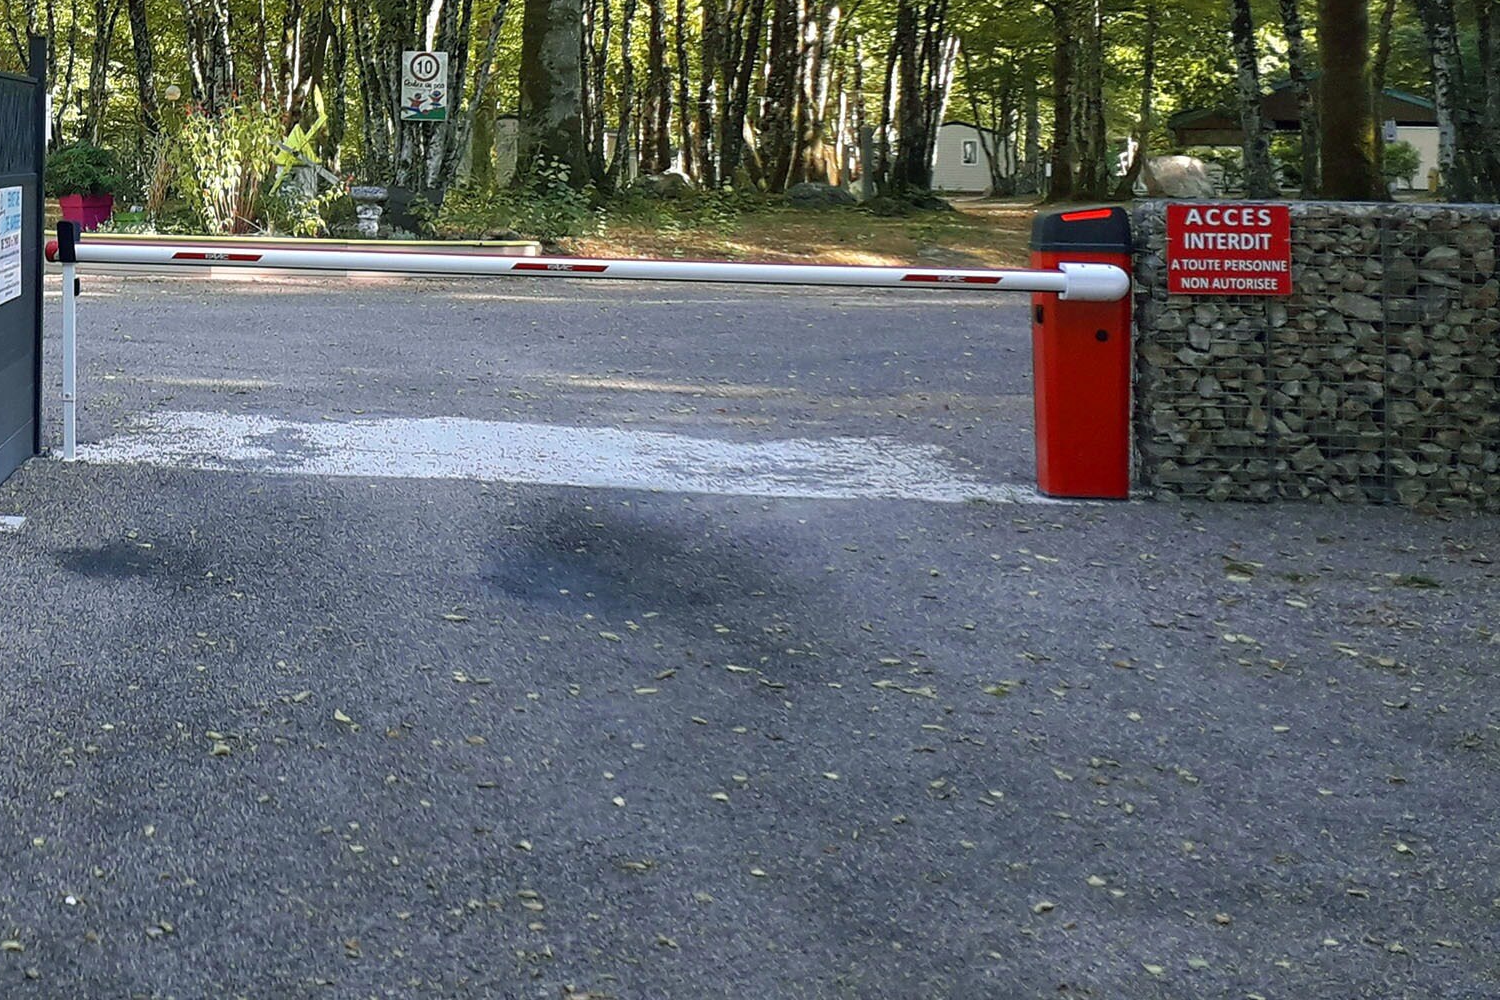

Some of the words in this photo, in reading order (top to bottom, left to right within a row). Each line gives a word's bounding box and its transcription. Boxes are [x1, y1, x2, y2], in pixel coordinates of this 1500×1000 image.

[417, 60, 433, 75] 10
[1184, 208, 1272, 226] ACCES
[1184, 232, 1273, 250] INTERDIT
[1171, 259, 1180, 271] A
[1181, 259, 1221, 271] TOUTE
[1224, 260, 1289, 272] PERSONNE
[1181, 277, 1209, 289] NON
[1212, 278, 1279, 290] AUTORISEE
